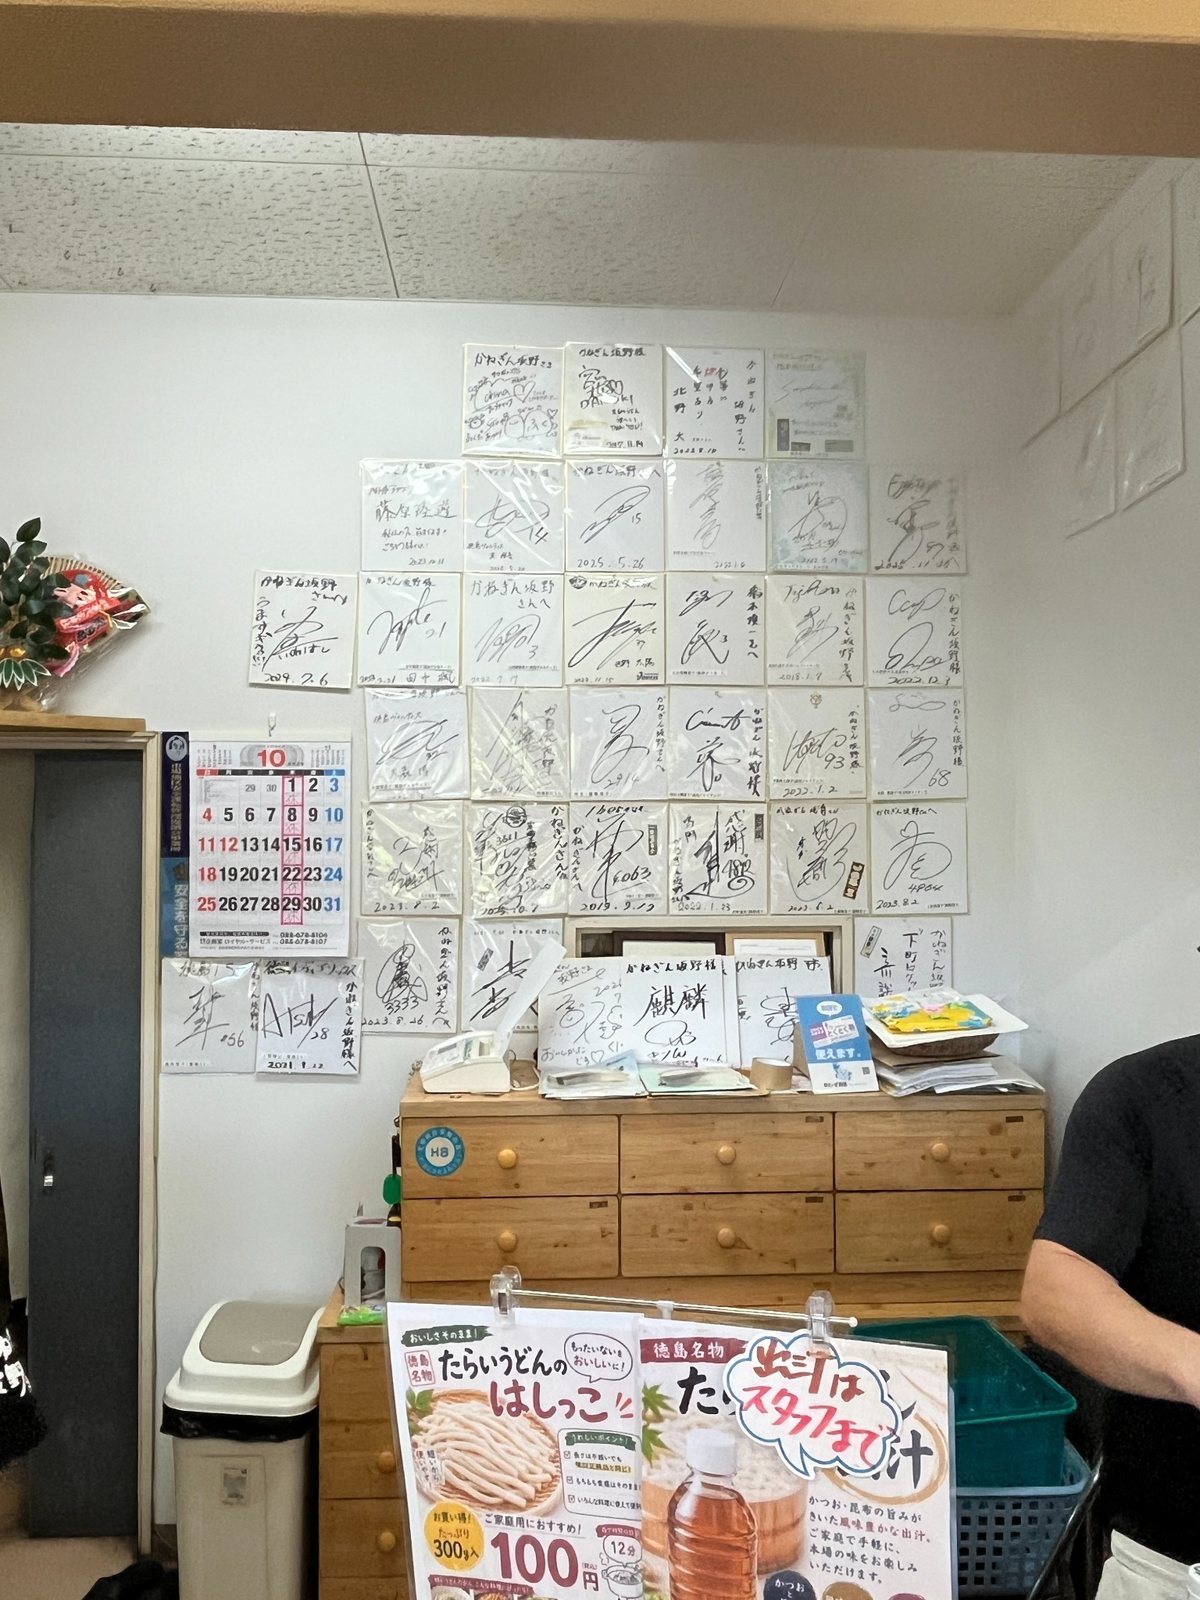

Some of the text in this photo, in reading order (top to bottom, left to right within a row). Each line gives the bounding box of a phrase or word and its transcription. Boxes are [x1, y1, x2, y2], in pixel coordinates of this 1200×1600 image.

[257, 749, 287, 768] 10
[245, 778, 339, 792] 29 30 1 2 3
[928, 768, 952, 788] 68
[202, 808, 343, 822] 4 5 6 7 8 9 10
[199, 837, 343, 852] 11 12 13 14 15 16 17
[199, 867, 343, 881] 18 19 20 21 22 23 24
[197, 896, 341, 911] 25 26 27 28 29 30 31
[626, 958, 717, 974] かねぎん坂野様
[815, 1047, 862, 1061] 使えます。
[409, 1329, 479, 1344] おいしさそのまま!
[570, 1341, 623, 1358] もったいないを
[653, 1340, 724, 1359] 徳島名物
[407, 1353, 430, 1368] 徳島
[437, 1346, 568, 1381] たらいうどんの
[573, 1357, 626, 1372] おいしいに!
[411, 1368, 433, 1383] 名物
[489, 1378, 608, 1423] はしっこ
[742, 1384, 890, 1467] スタッフまで
[808, 1496, 922, 1523] かつお・昆布の旨みが
[485, 1512, 582, 1535] ご家庭用におすすめ!
[809, 1511, 931, 1543] きいた風味豊かな出汁。
[438, 1527, 470, 1539] たっぷり
[809, 1528, 901, 1555] ご家庭で手軽に、
[610, 1540, 636, 1557] 12分
[490, 1531, 579, 1588] 100
[809, 1544, 918, 1573] 本場の味をお楽しみ
[582, 1570, 600, 1592] 円
[809, 1561, 883, 1585] いただけます。
[774, 1578, 806, 1593] かつお
